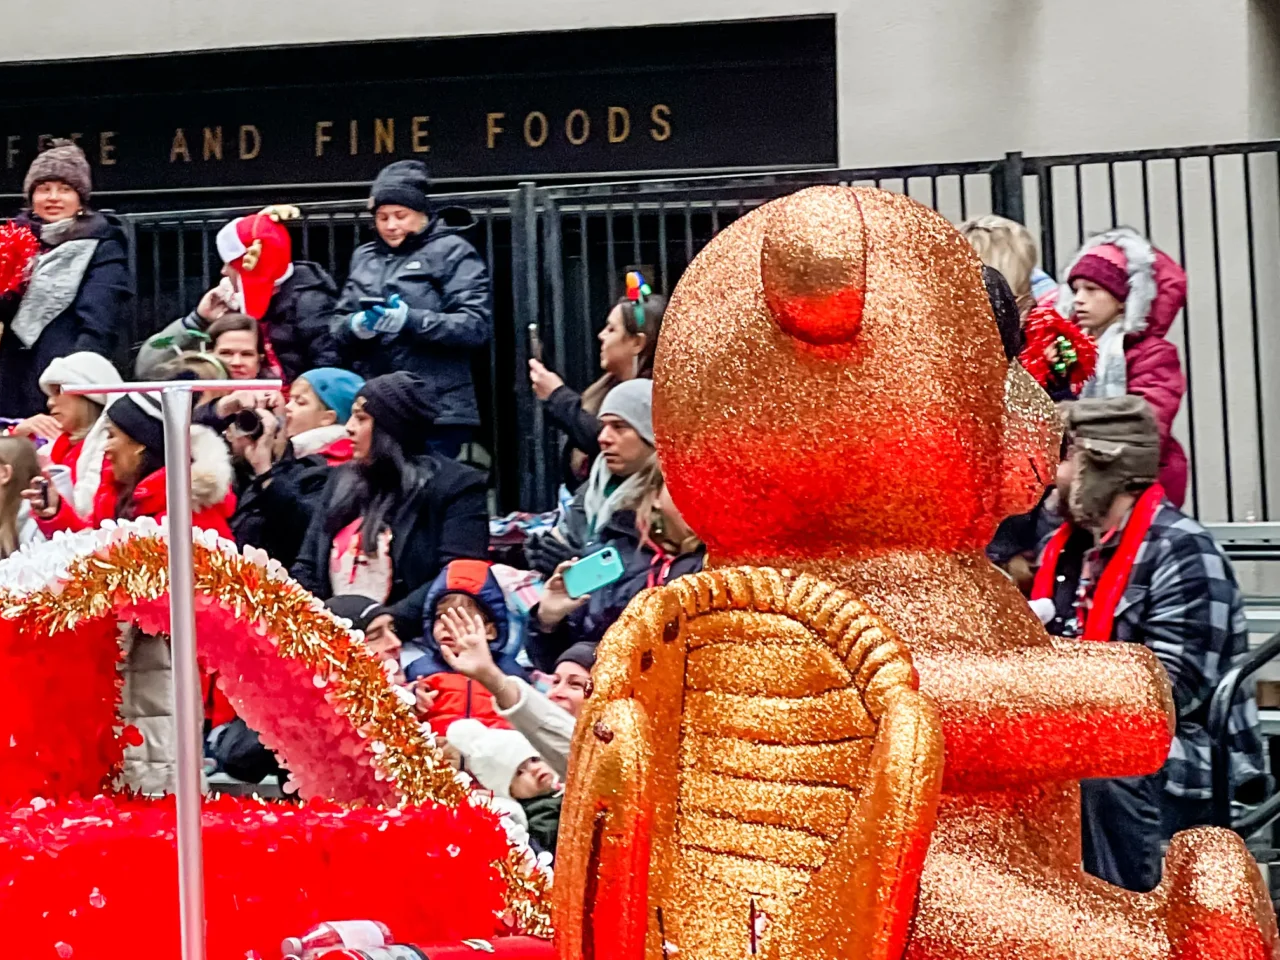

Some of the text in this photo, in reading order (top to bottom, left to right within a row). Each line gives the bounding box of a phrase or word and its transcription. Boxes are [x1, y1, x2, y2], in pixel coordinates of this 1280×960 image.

[170, 124, 262, 161] AND
[315, 115, 431, 157] FINE
[486, 104, 672, 149] FOODS
